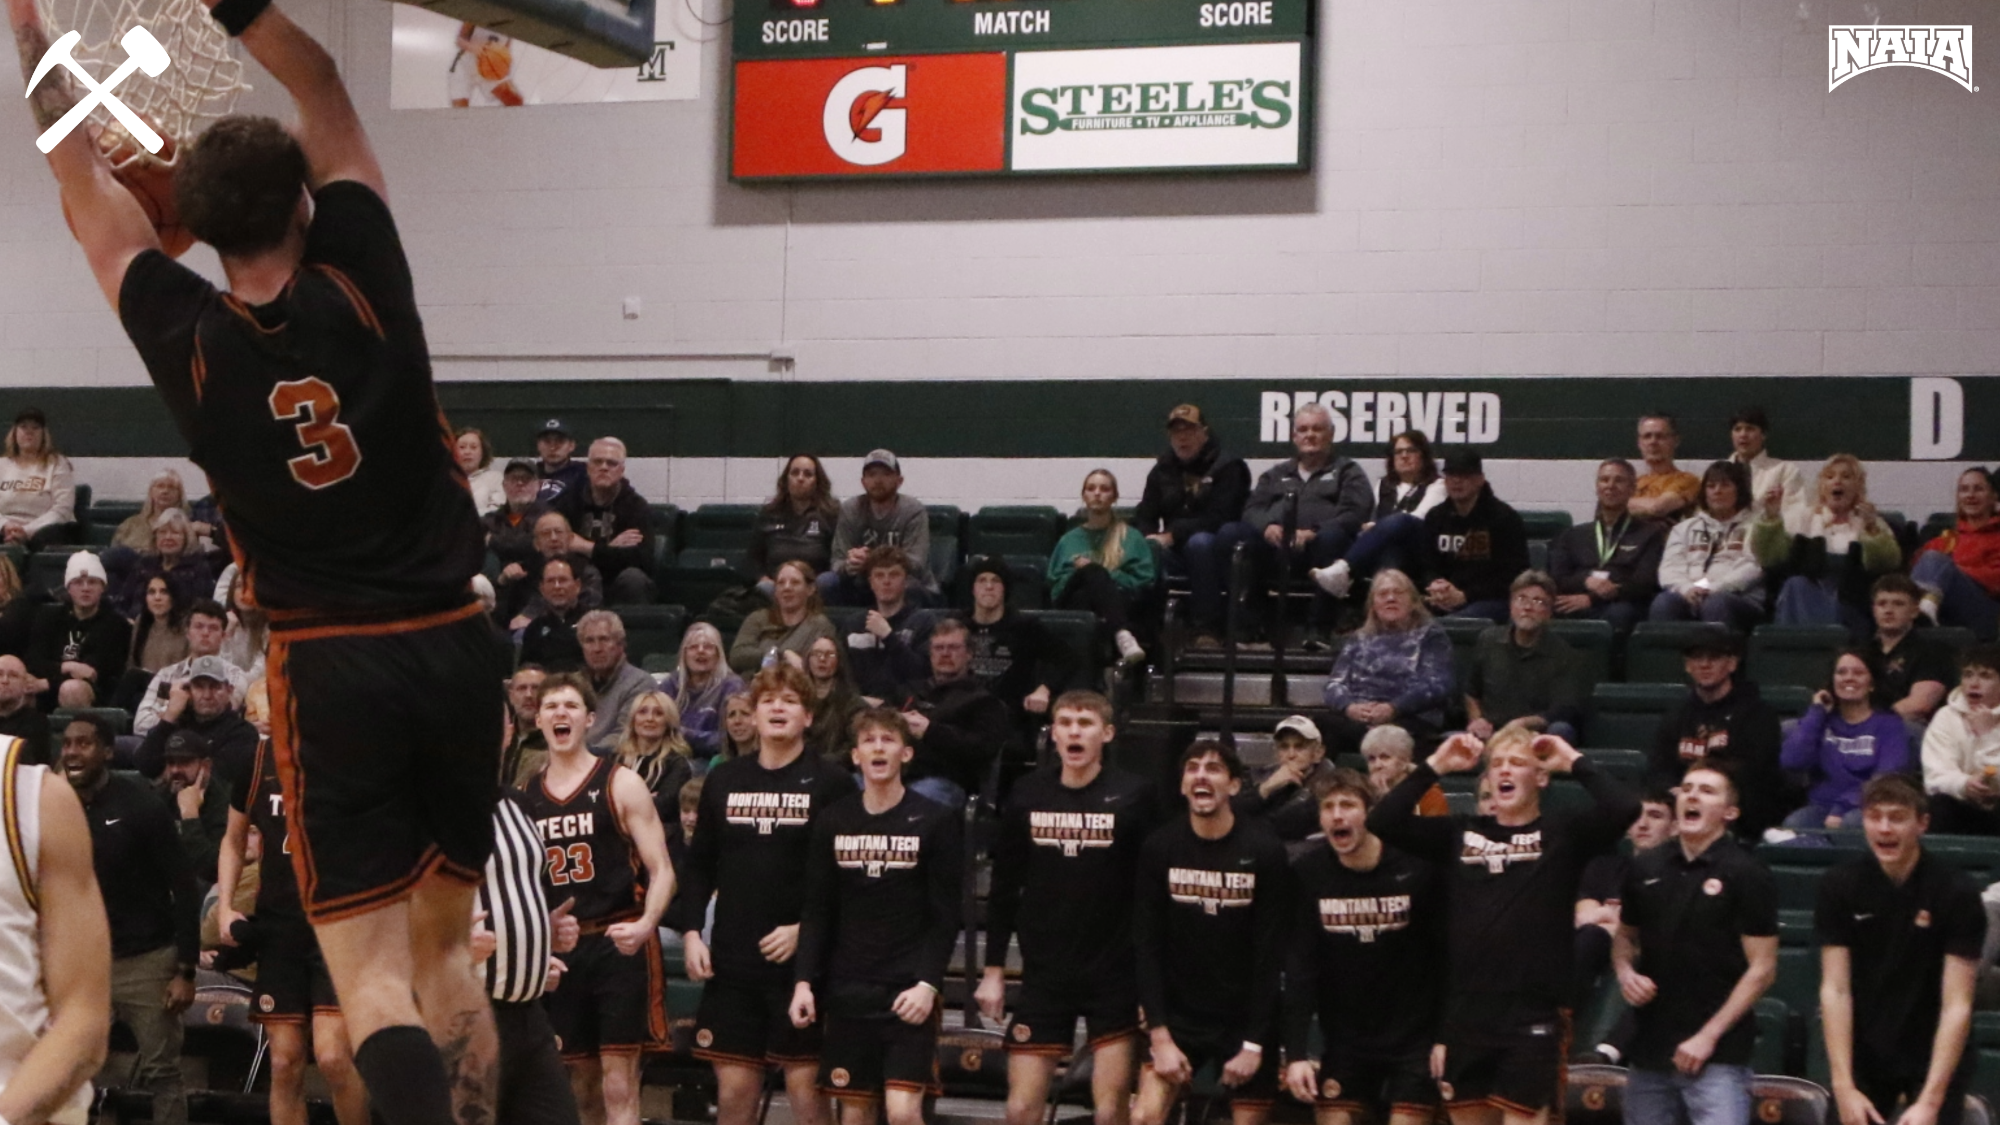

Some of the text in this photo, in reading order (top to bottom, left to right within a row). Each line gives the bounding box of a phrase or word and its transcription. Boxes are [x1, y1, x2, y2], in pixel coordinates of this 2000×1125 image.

[974, 9, 1050, 36] MATCH
[1199, 1, 1272, 28] SCORE
[762, 18, 829, 44] SCORE
[822, 63, 908, 166] G
[1020, 78, 1292, 136] STEELE'S
[1071, 113, 1236, 130] FURNITURE TV APPLIANCE
[1910, 377, 1964, 460] D
[268, 376, 362, 490] 3
[727, 792, 810, 809] MONTANA TECH
[536, 812, 594, 840] TECH
[1030, 811, 1115, 829] MONTANA TECH
[834, 834, 920, 852] MONTANA TECH
[546, 843, 595, 886] 23
[1169, 867, 1255, 889] MONTANA TECH
[1319, 895, 1410, 915] MONTANA TECH
